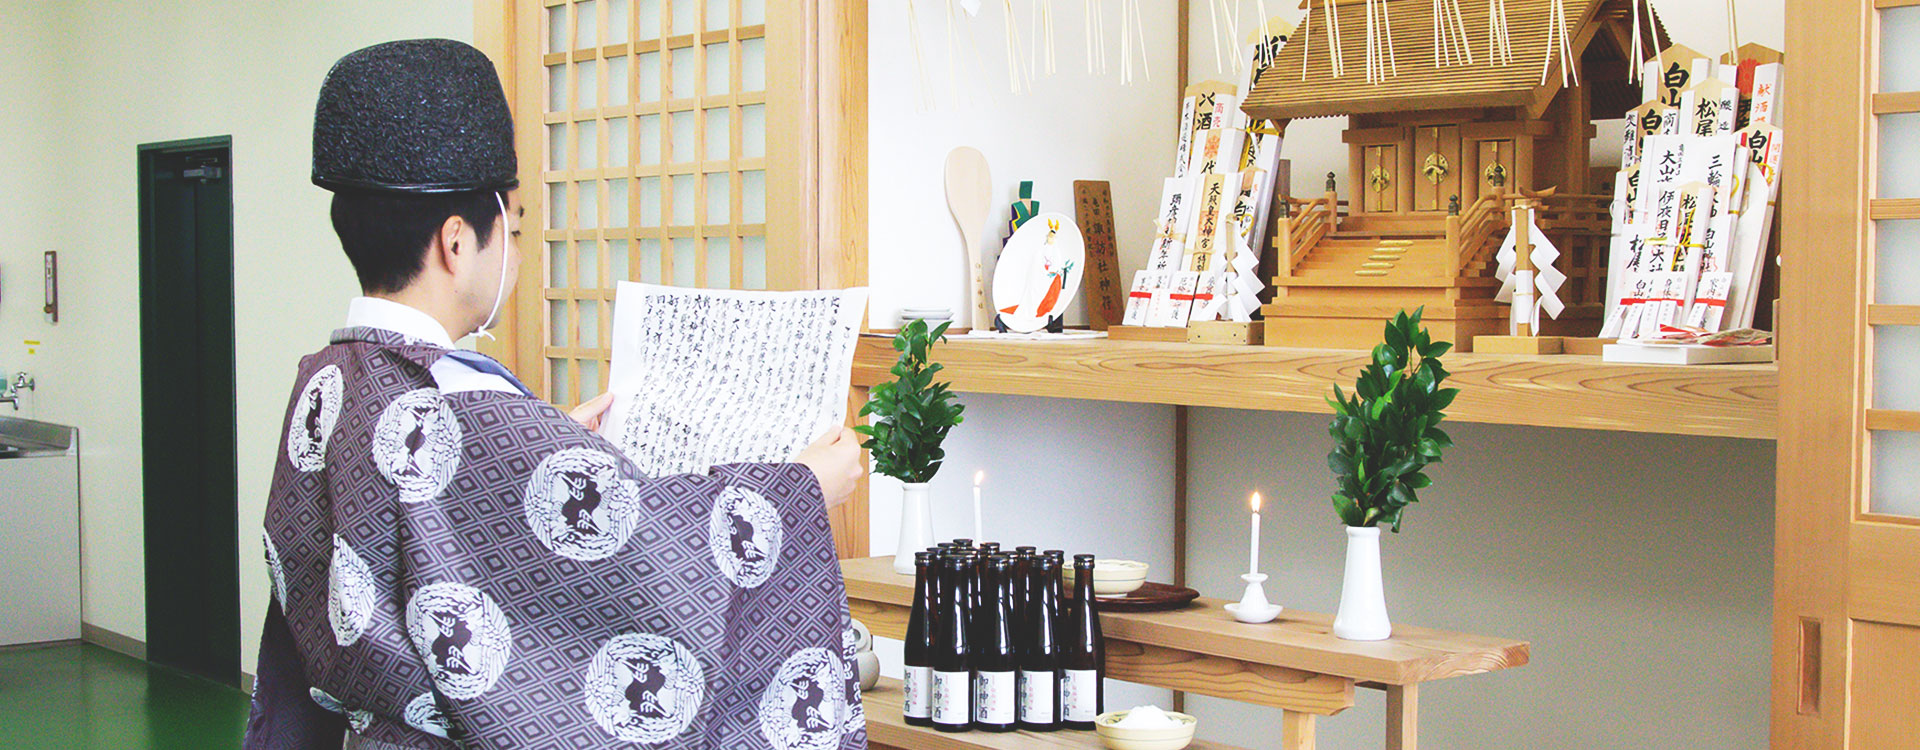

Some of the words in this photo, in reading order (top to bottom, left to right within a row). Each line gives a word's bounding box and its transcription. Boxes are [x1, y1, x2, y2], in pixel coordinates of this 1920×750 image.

[1661, 62, 1690, 109] 白山
[1695, 97, 1718, 136] 松尾
[1633, 279, 1646, 300] 白山
